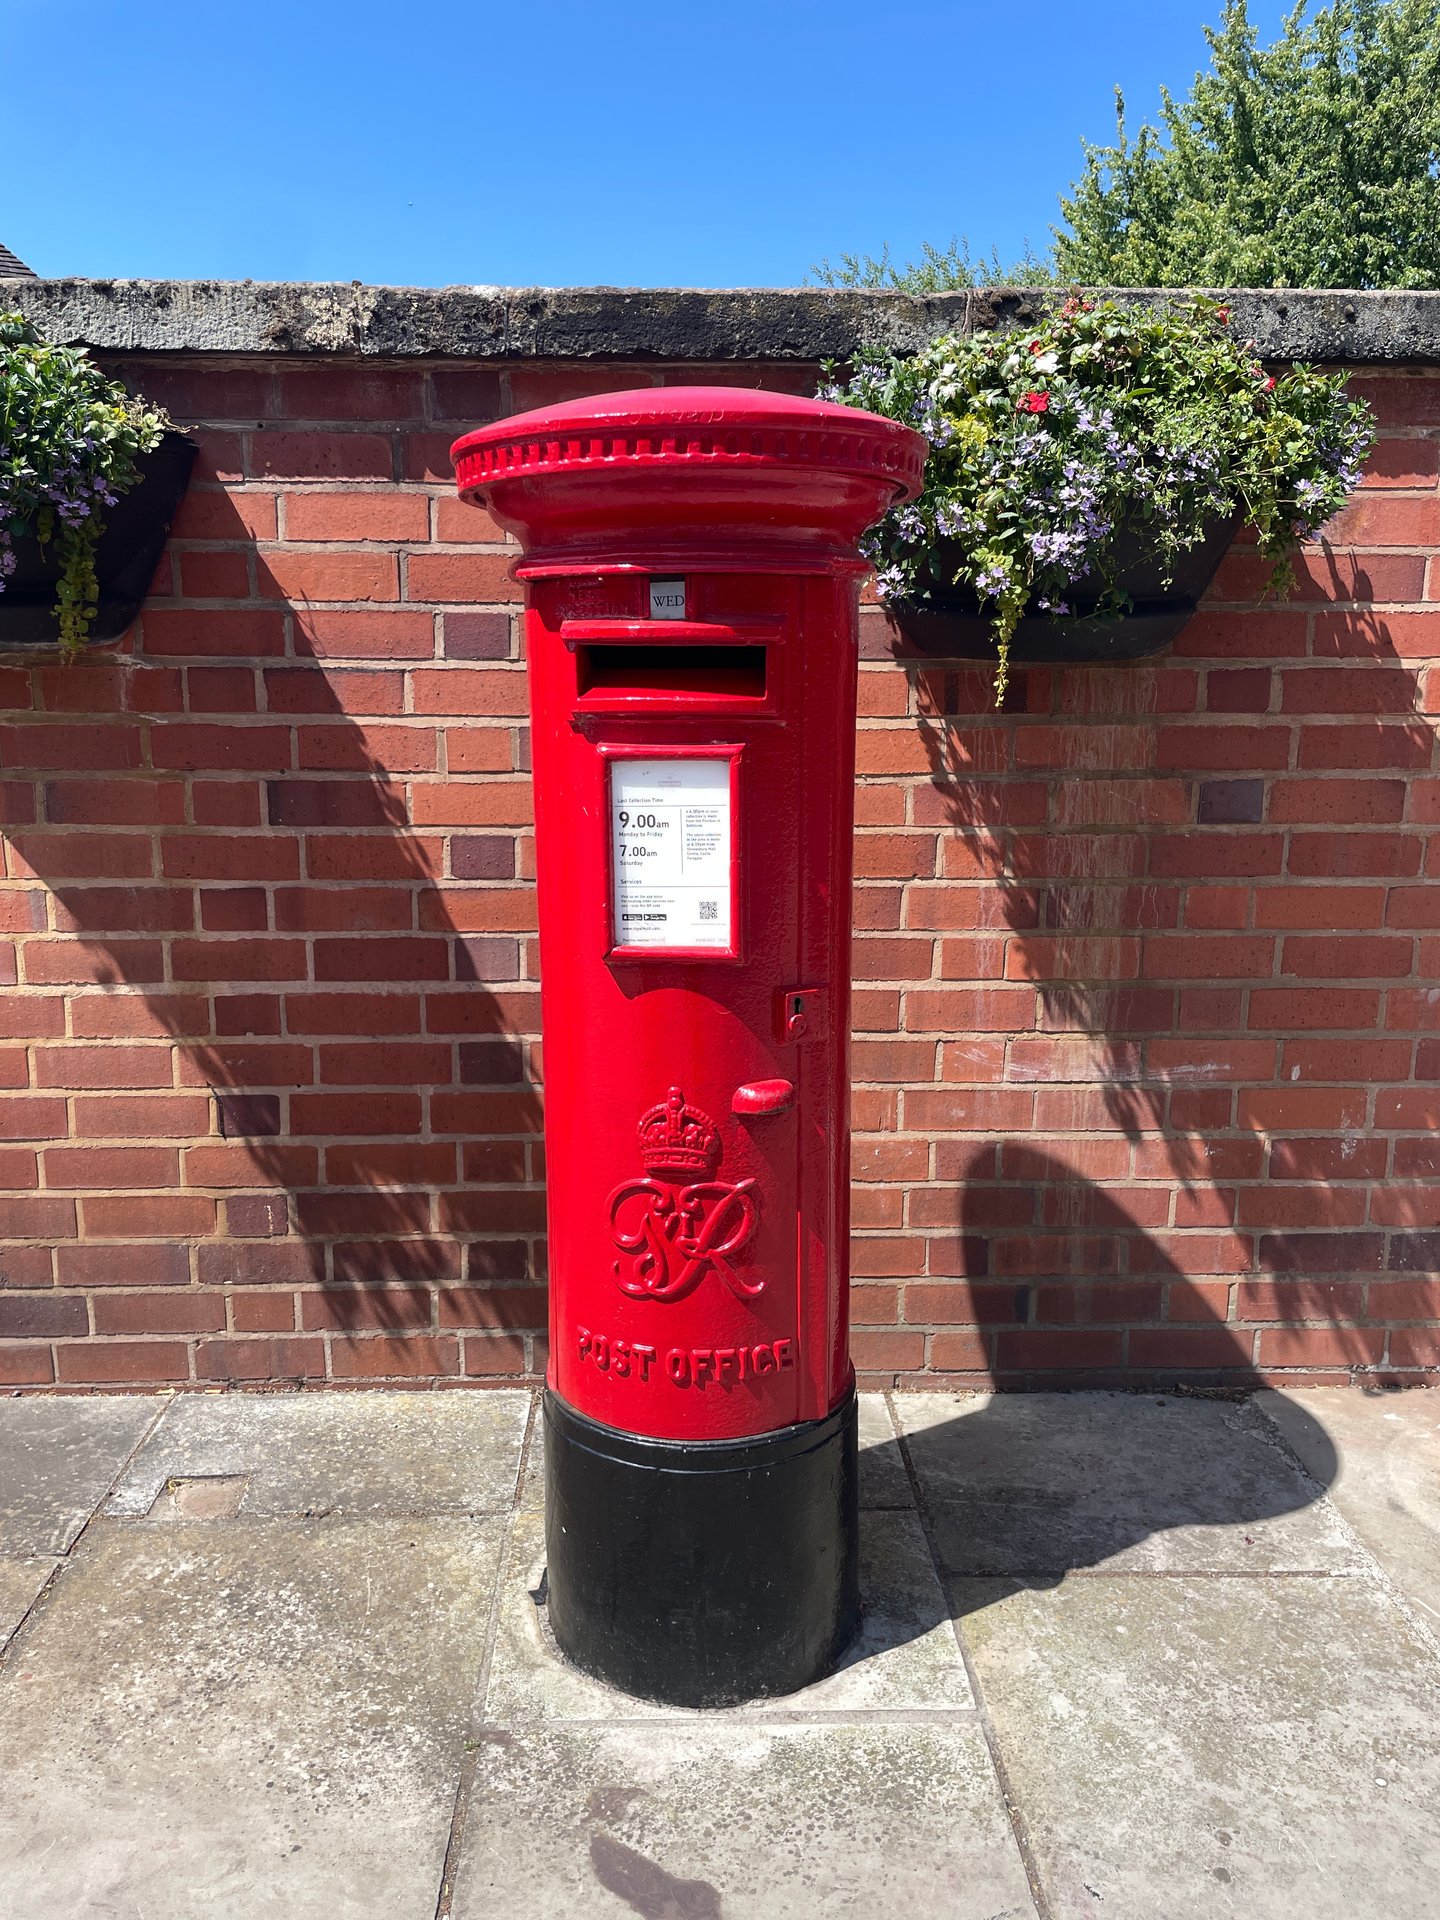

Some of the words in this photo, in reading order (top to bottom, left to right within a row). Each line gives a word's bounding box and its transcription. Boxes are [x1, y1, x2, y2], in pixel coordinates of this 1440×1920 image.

[652, 594, 685, 607] WED
[618, 811, 669, 828] 9.00am
[619, 845, 658, 856] 7.00am
[576, 1325, 656, 1382] POST
[665, 1338, 795, 1382] OFFICE
